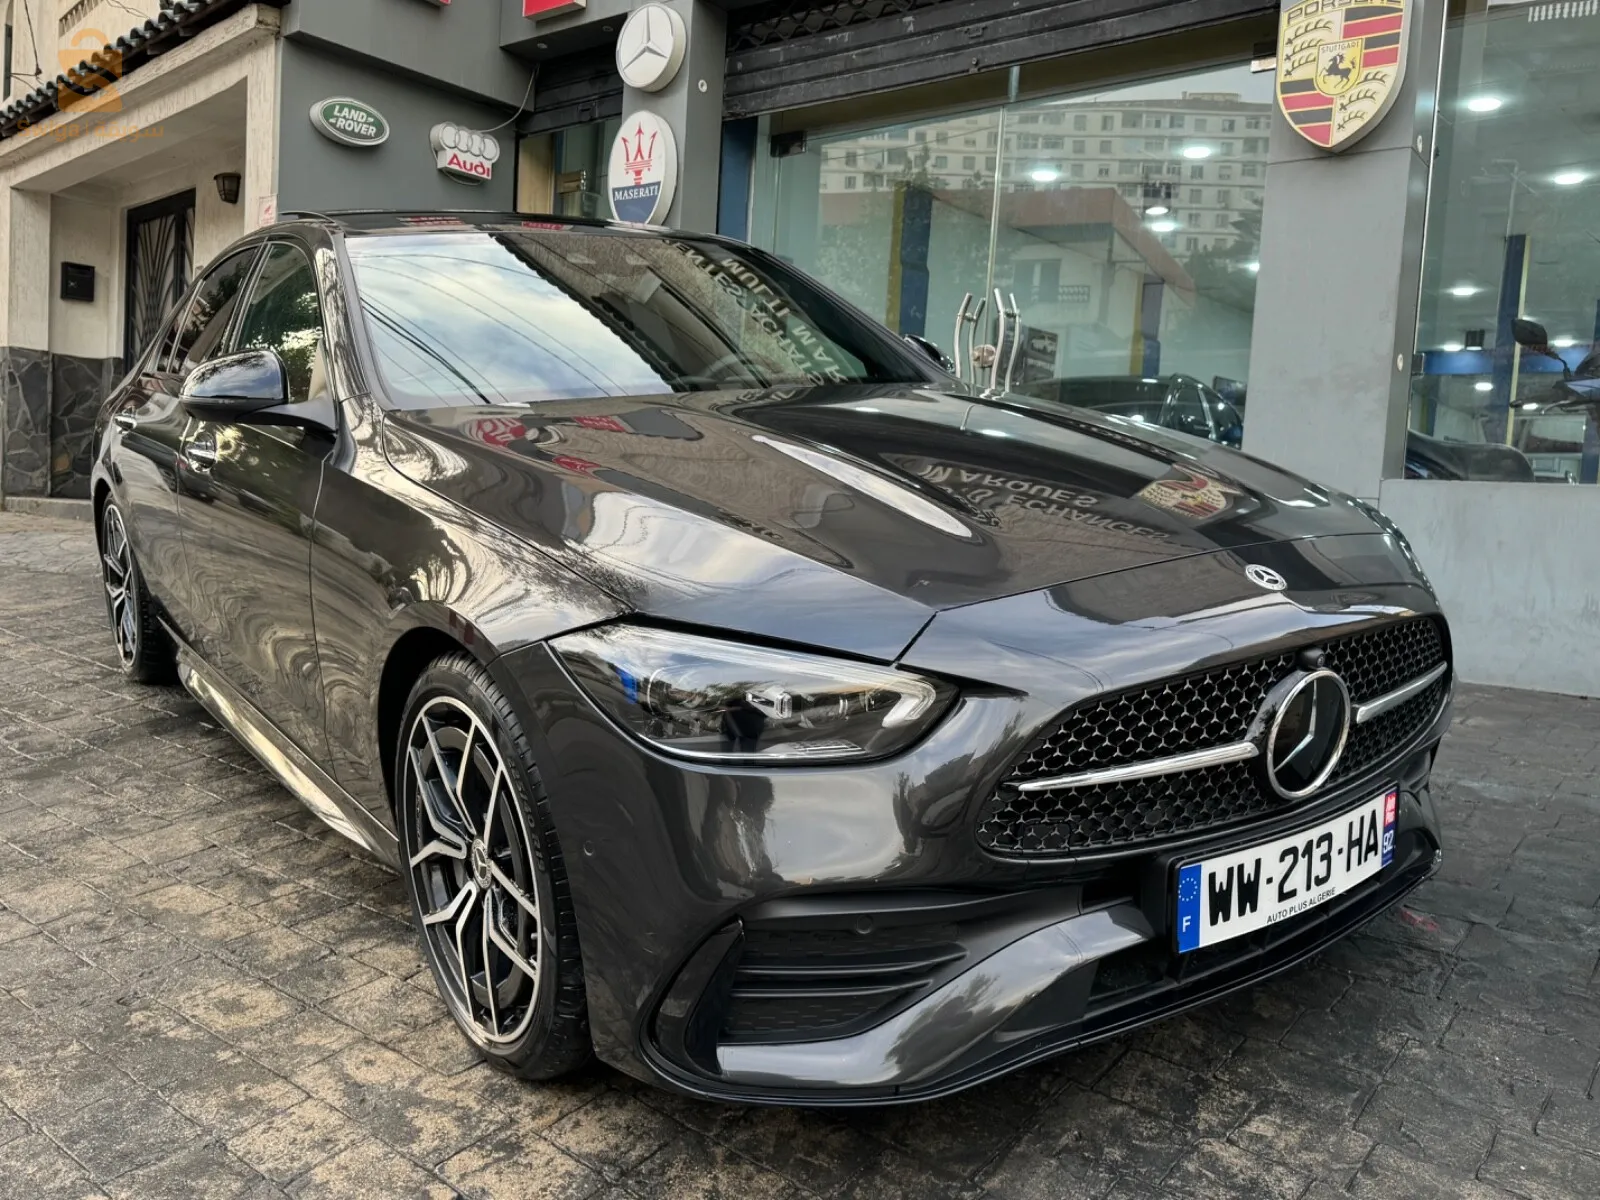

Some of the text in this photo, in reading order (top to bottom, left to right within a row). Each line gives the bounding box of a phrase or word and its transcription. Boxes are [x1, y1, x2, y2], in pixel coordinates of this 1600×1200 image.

[1320, 42, 1360, 54] STUTTGART
[333, 104, 367, 123] LAND
[336, 117, 377, 137] ROVER
[447, 153, 491, 178] Audi
[614, 185, 659, 201] MASERATI
[1208, 808, 1379, 927] WW-213-HA
[1266, 886, 1336, 924] AUTO PLUS ALGERIE
[1181, 915, 1192, 933] F
